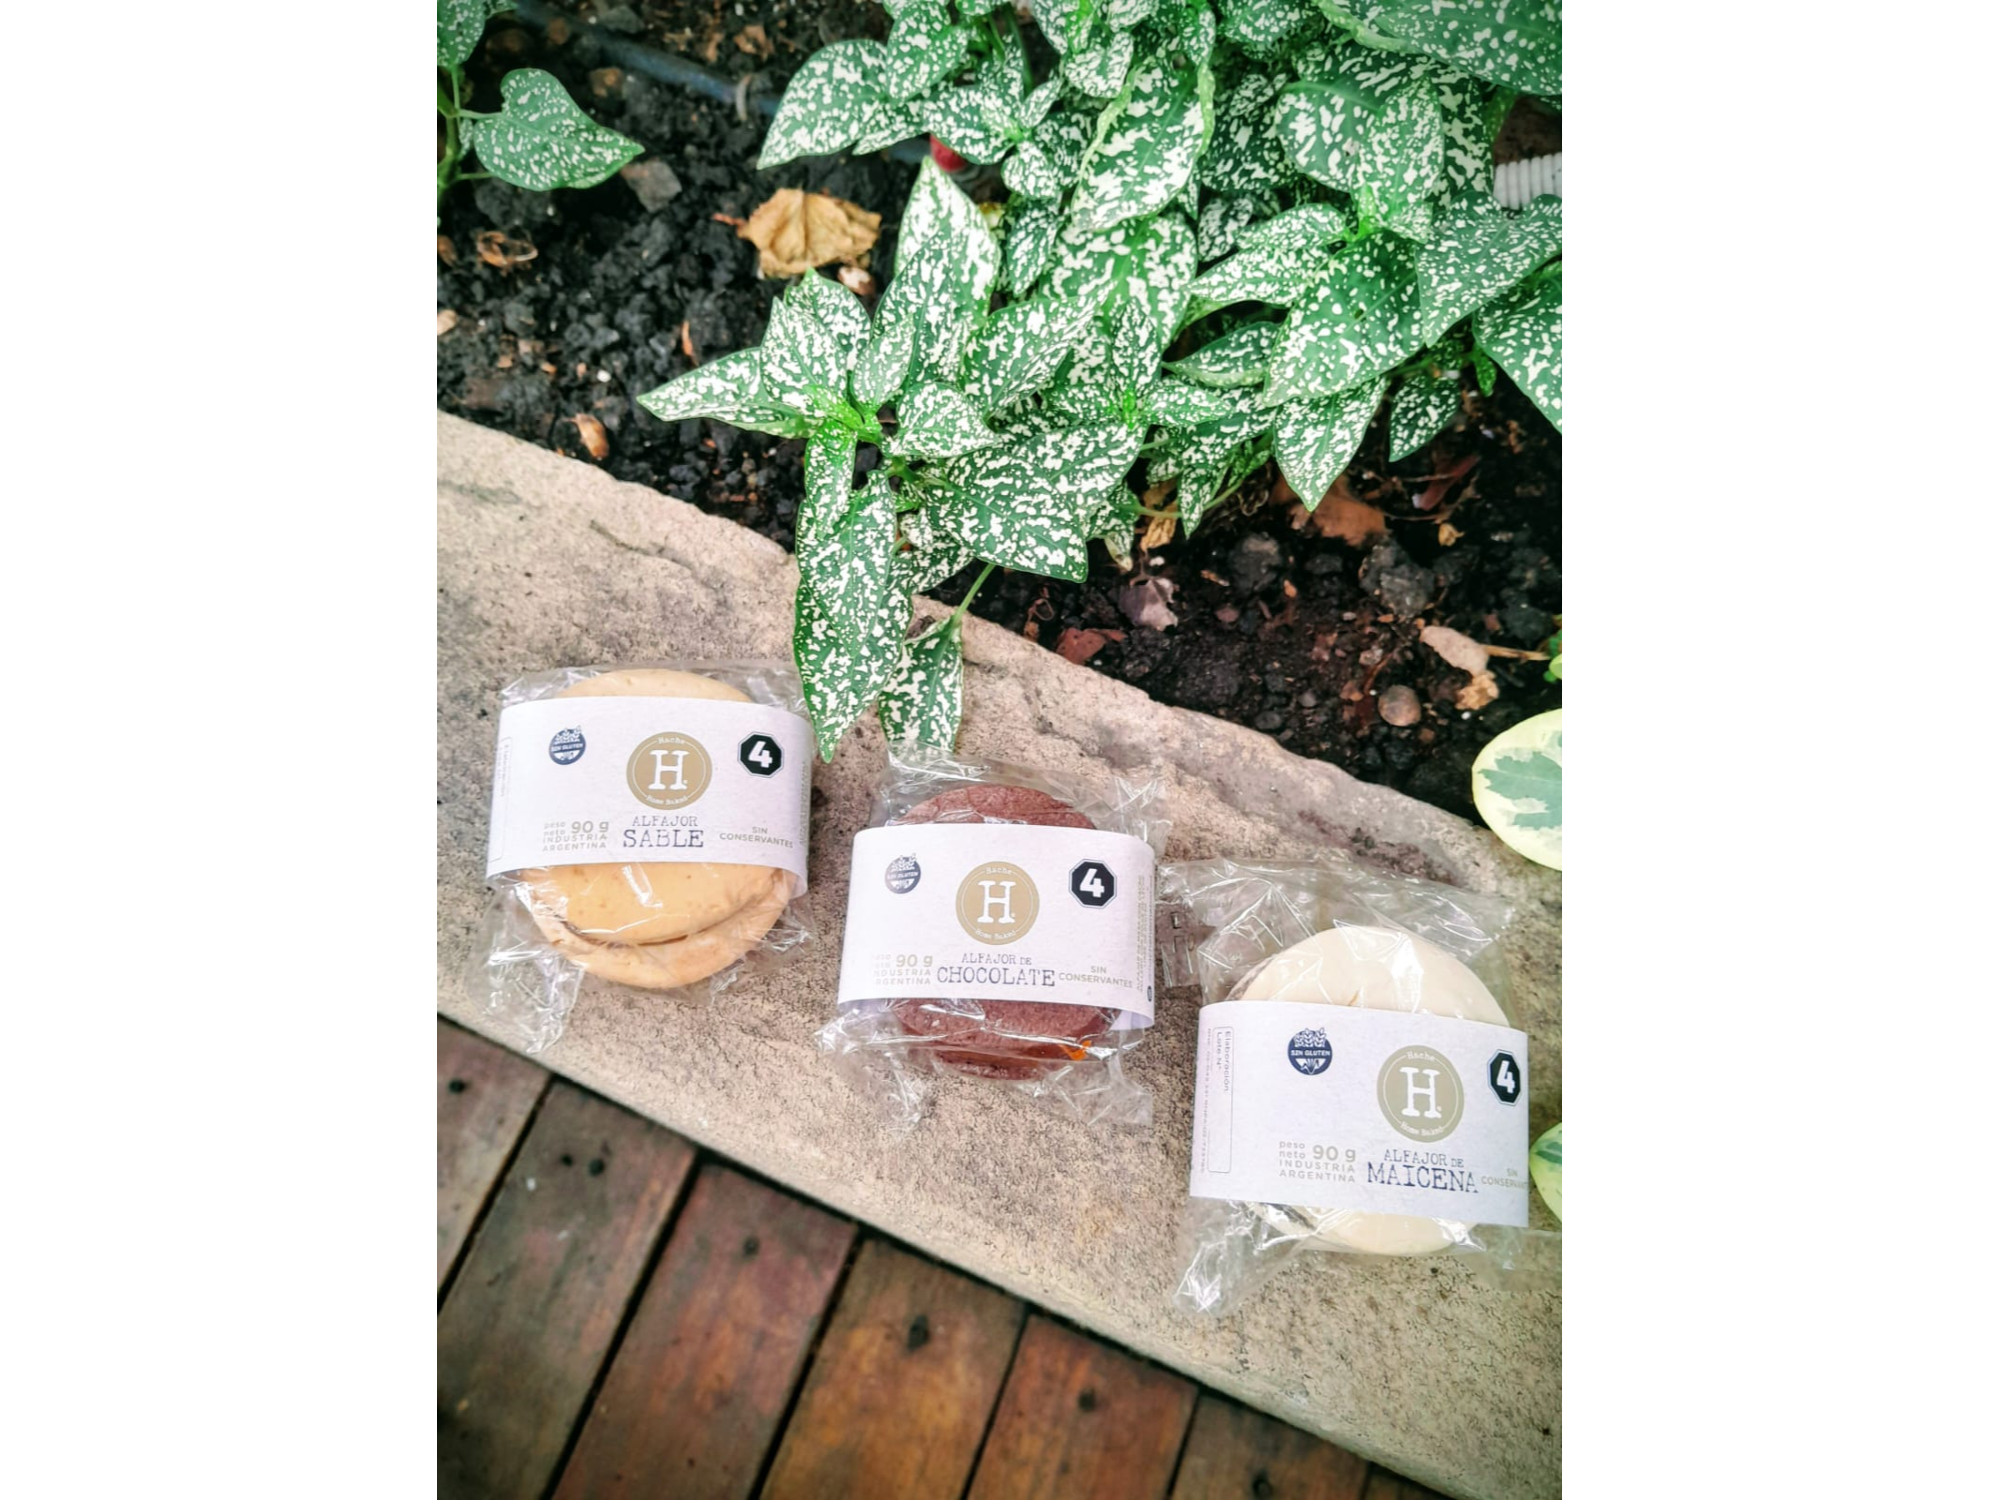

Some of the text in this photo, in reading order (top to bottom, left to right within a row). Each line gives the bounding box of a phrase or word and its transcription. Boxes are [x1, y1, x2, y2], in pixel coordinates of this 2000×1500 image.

[748, 741, 773, 768] 4
[571, 820, 594, 834] 90
[599, 821, 609, 833] g
[632, 815, 698, 827] ALFAJOR
[752, 826, 768, 834] SIN
[543, 833, 608, 844] INDUSTRIA
[623, 829, 704, 848] SABLE
[719, 832, 793, 848] CONSERVANTES
[542, 842, 607, 852] ARGENTINA
[1080, 868, 1105, 898] 4
[896, 953, 918, 967] 90
[923, 955, 933, 967] g
[961, 953, 1032, 965] ALFAJOR DE
[874, 968, 931, 977] NDUSTRIA
[1091, 965, 1106, 973] SIN
[876, 977, 931, 986] RGENTINA
[937, 966, 1055, 987] CHOCOLATE
[1059, 972, 1133, 988] CONSERVANTES
[1496, 1060, 1515, 1093] 4
[1279, 1141, 1306, 1150] peso
[1279, 1144, 1356, 1162] neto 90 g
[1384, 1149, 1464, 1168] ALFAJOR DE
[1279, 1159, 1355, 1173] INDUSTRIA
[1279, 1170, 1356, 1184] ARGENTINA
[1367, 1162, 1479, 1194] MAICENA
